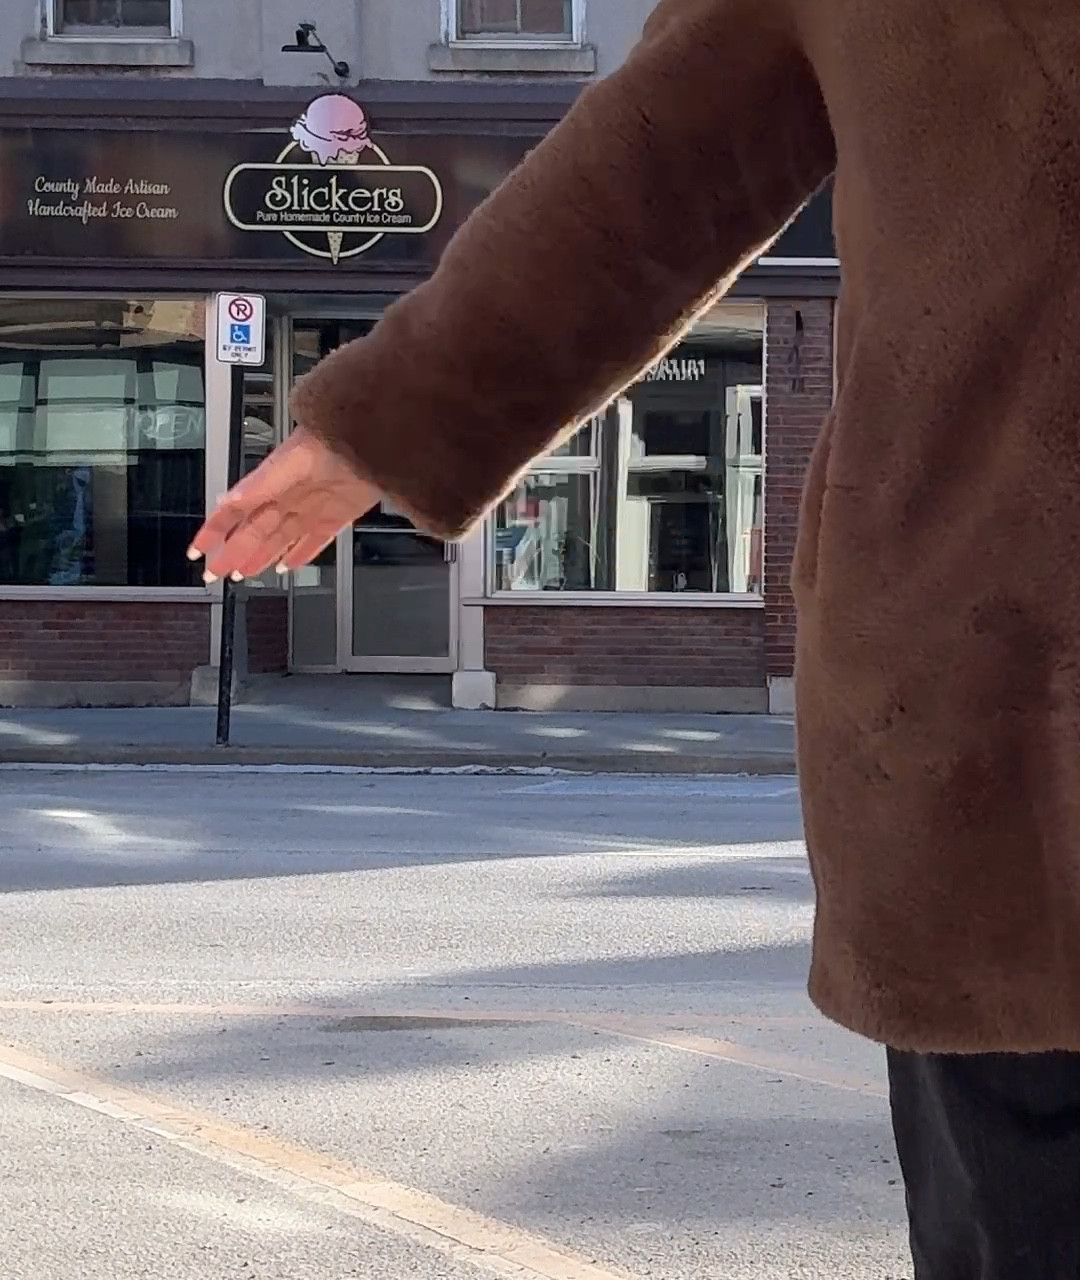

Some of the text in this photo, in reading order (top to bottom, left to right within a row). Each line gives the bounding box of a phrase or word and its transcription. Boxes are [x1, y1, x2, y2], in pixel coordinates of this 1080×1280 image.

[35, 175, 171, 200] County Made Artisan
[264, 174, 404, 212] Slickers
[27, 198, 179, 225] Handcrafted Ice Cream
[256, 210, 411, 224] Pure Homemade County Ice Cream
[139, 411, 203, 433] OPEN
